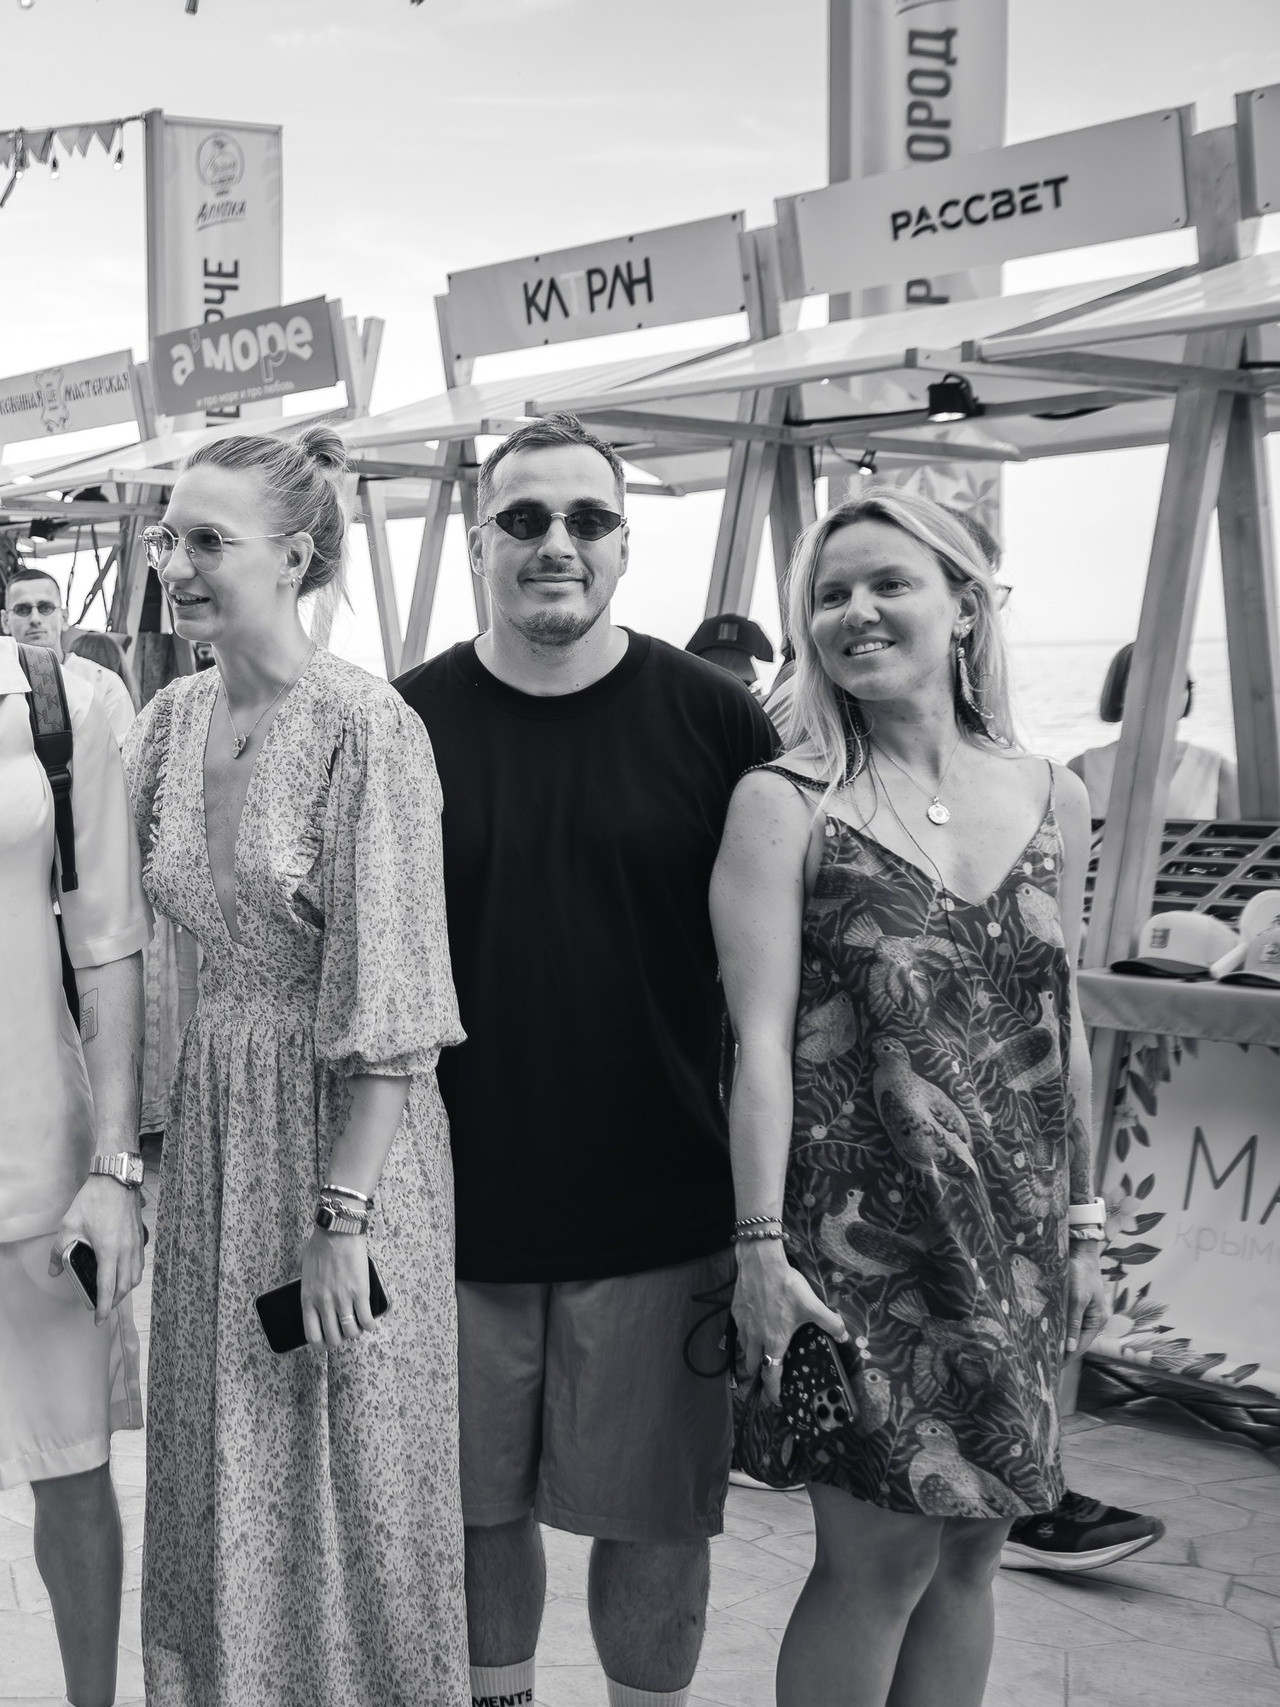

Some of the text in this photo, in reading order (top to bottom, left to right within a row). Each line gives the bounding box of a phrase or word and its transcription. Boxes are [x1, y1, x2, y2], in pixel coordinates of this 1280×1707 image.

[889, 174, 1069, 241] РАССВЕТ
[64, 372, 131, 402] МАСТЕРСКАЯ
[1174, 1221, 1280, 1266] крым
